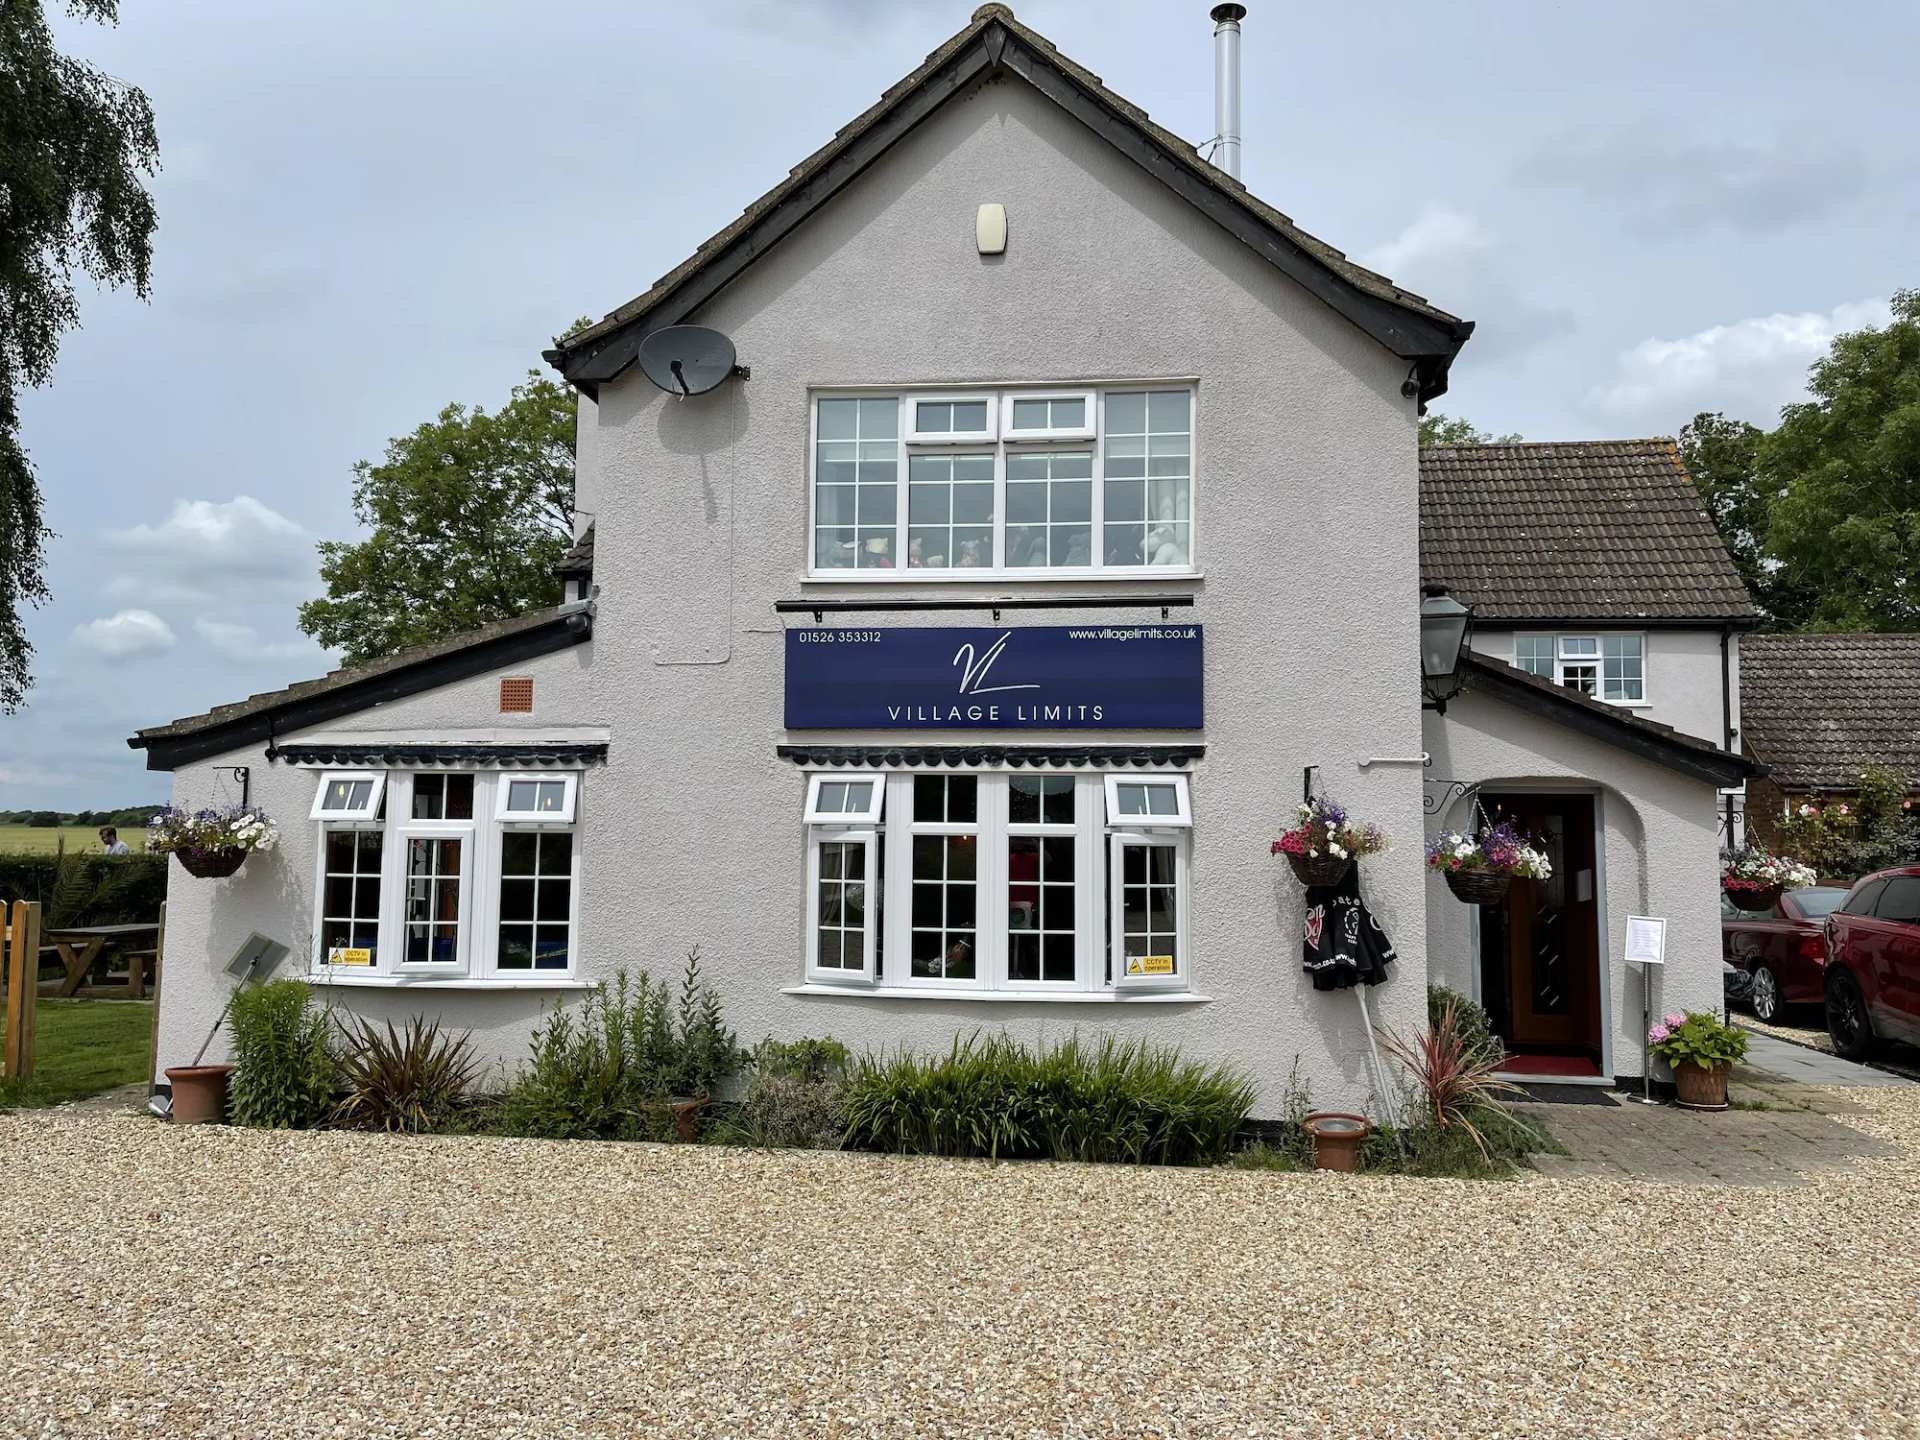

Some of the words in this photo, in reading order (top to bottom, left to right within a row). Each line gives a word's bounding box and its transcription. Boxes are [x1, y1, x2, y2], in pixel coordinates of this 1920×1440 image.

[800, 631, 834, 643] 01526
[838, 631, 881, 643] 353312
[1069, 627, 1197, 642] www.villagelimits.co.uk
[887, 705, 999, 721] VILLAGE
[1018, 705, 1104, 721] LIMITS
